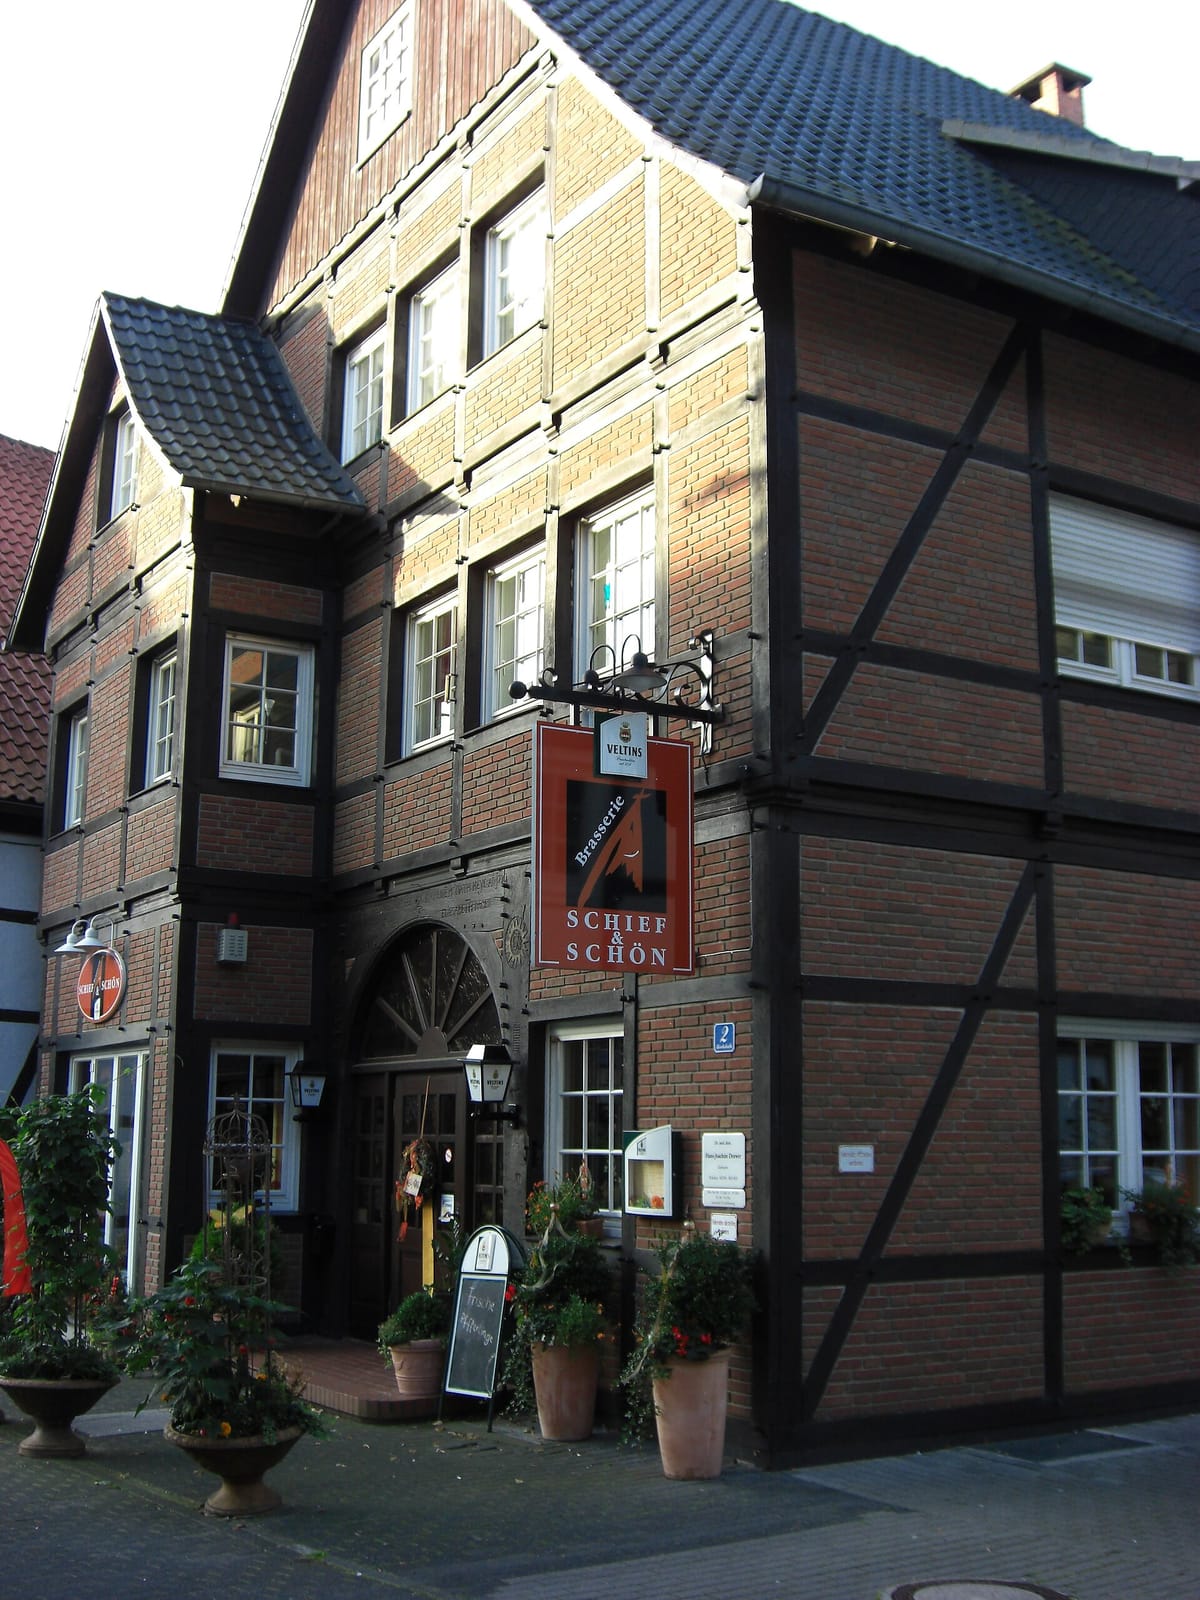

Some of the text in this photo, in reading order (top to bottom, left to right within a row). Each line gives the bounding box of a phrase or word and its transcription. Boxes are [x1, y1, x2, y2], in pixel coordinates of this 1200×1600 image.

[606, 743, 643, 758] VELTINS
[574, 795, 625, 867] Brasserie
[566, 909, 667, 934] SCHIEF
[611, 931, 624, 945] &
[566, 942, 667, 966] SCHÖN
[78, 983, 94, 995] SCHIEF
[101, 976, 120, 991] SCHÖN
[719, 1025, 729, 1043] 2
